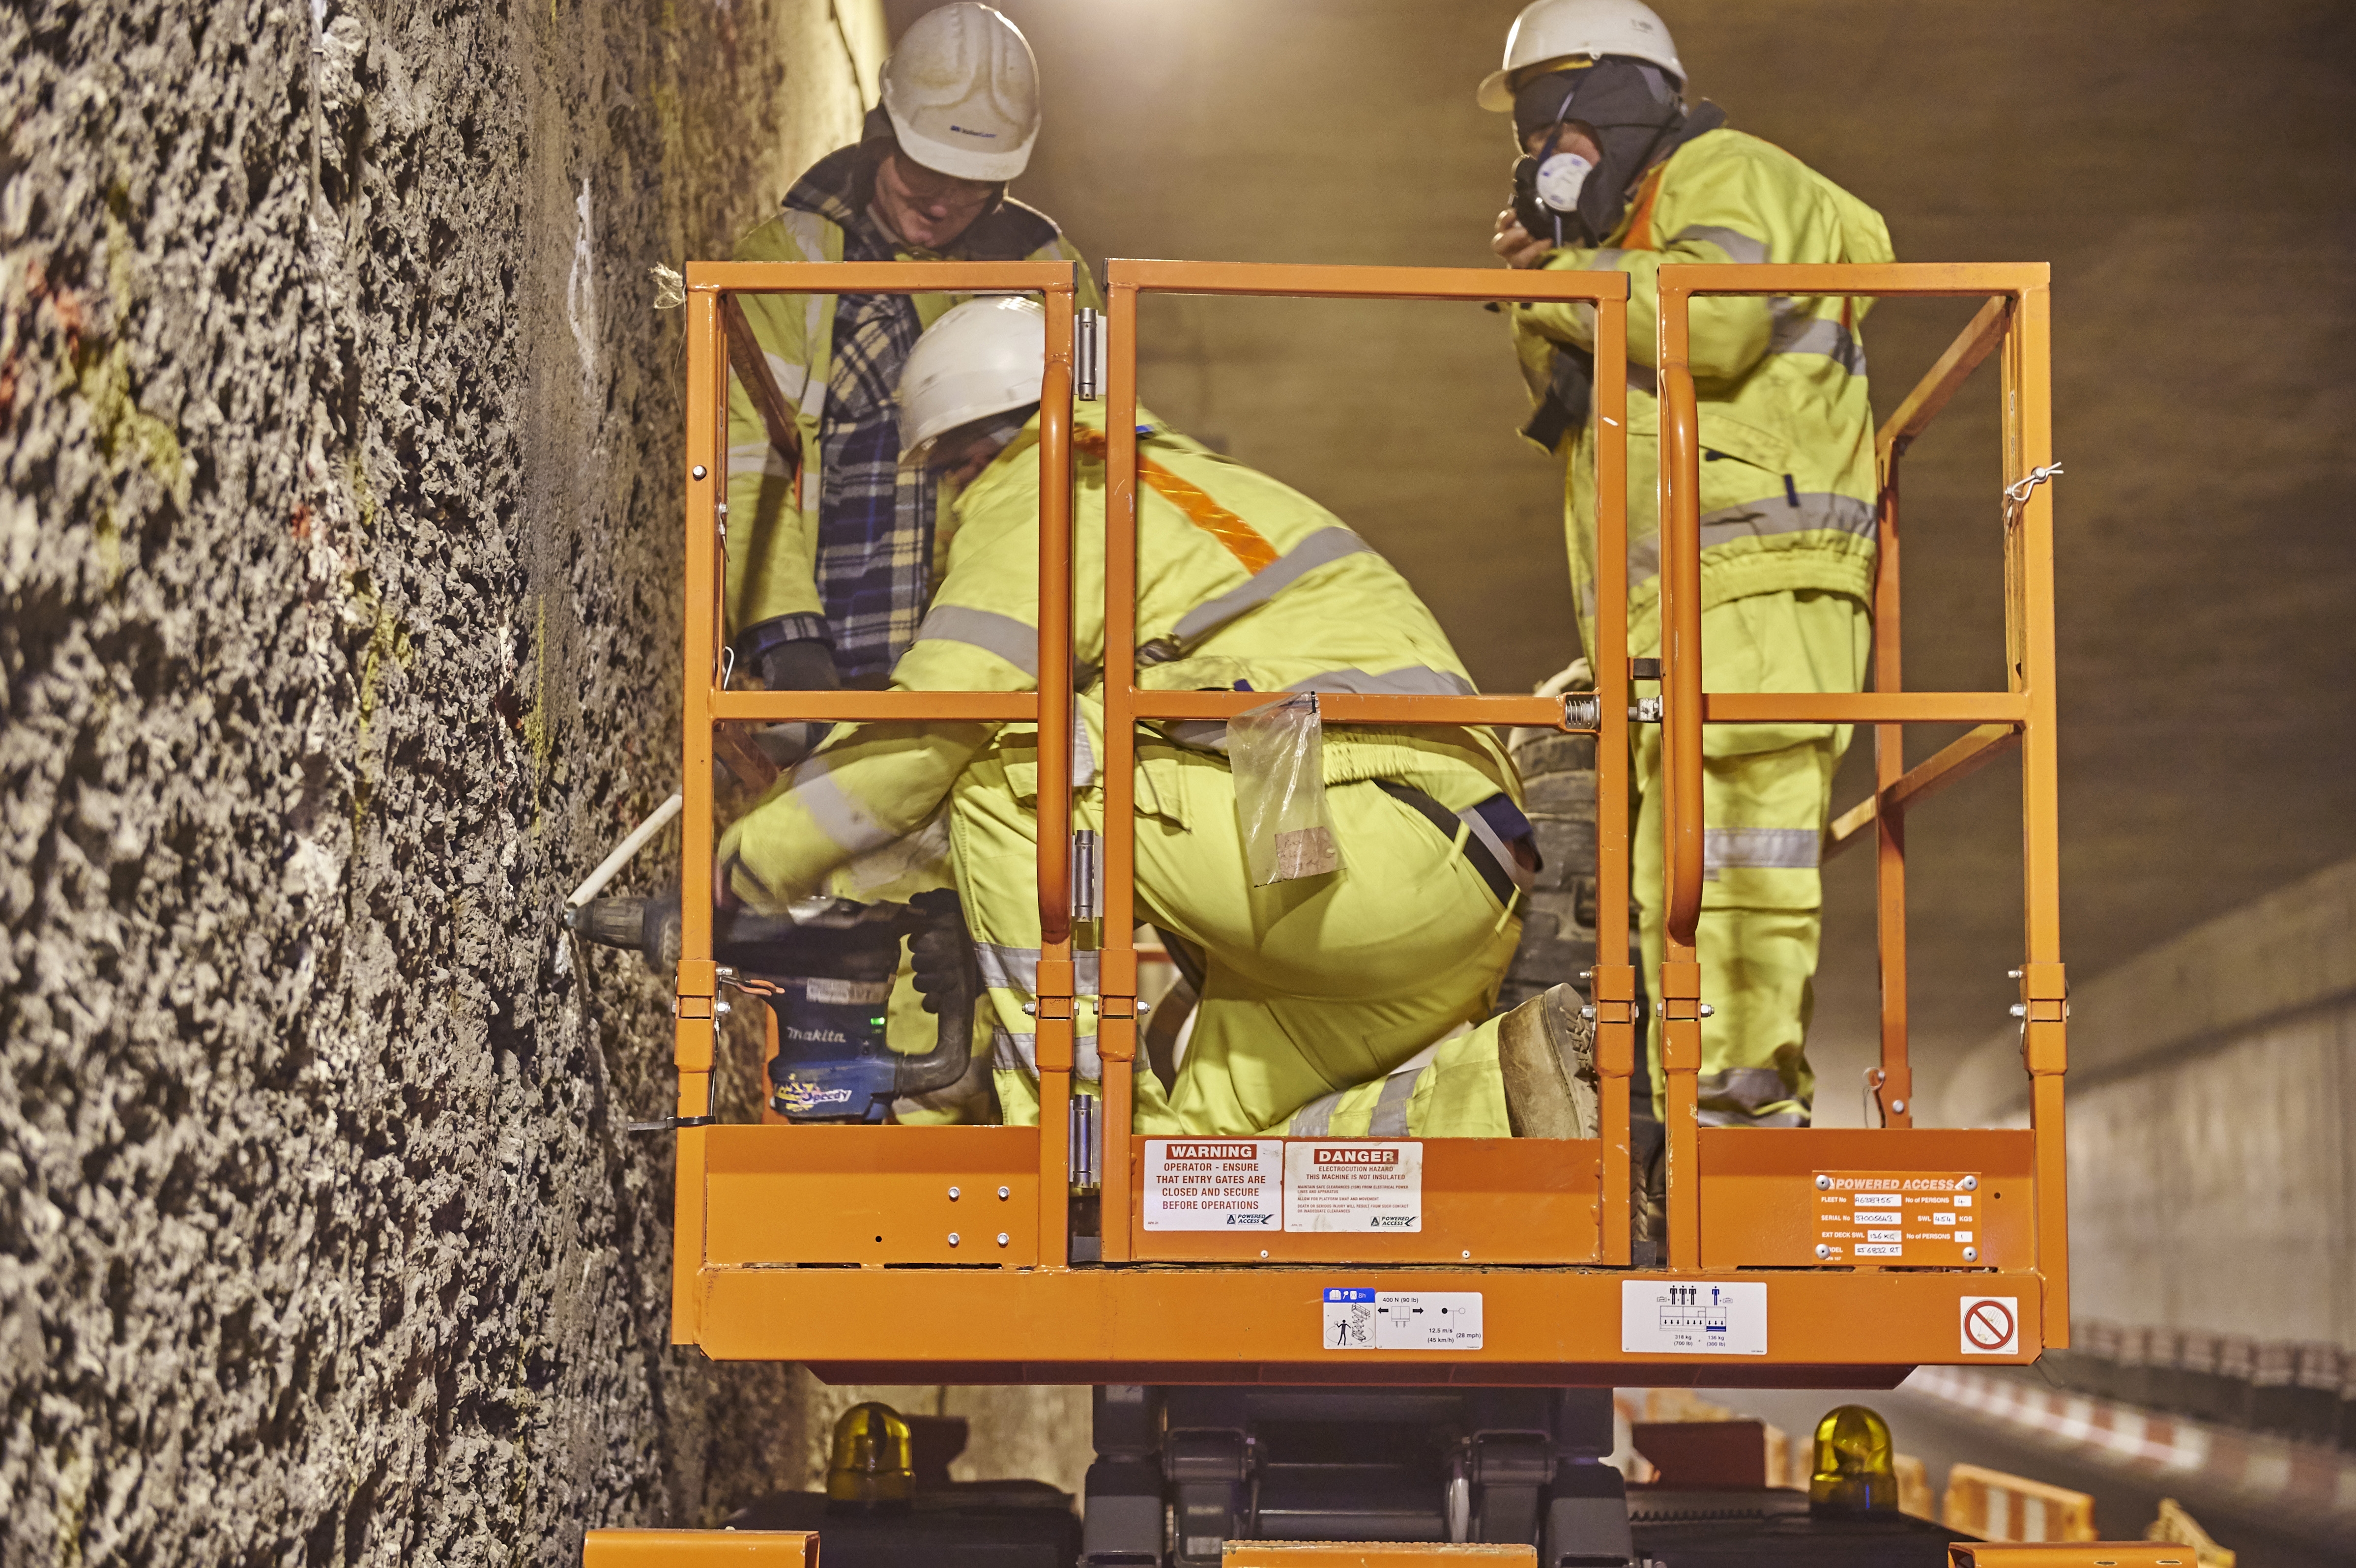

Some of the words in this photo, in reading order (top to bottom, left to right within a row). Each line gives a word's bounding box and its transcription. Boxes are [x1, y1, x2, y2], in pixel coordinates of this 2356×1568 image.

[1171, 1146, 1252, 1158] WARNING
[1319, 1151, 1395, 1162] DANGER
[1222, 1163, 1259, 1171] ENSURE
[1835, 1179, 1900, 1190] POWERED
[1902, 1179, 1954, 1190] ACCESS
[1162, 1188, 1197, 1196] CLOSED
[1201, 1188, 1220, 1196] AND
[1223, 1188, 1259, 1196] SECURE
[1163, 1201, 1198, 1209] BEFORE
[1201, 1201, 1259, 1209] OPERATIONS
